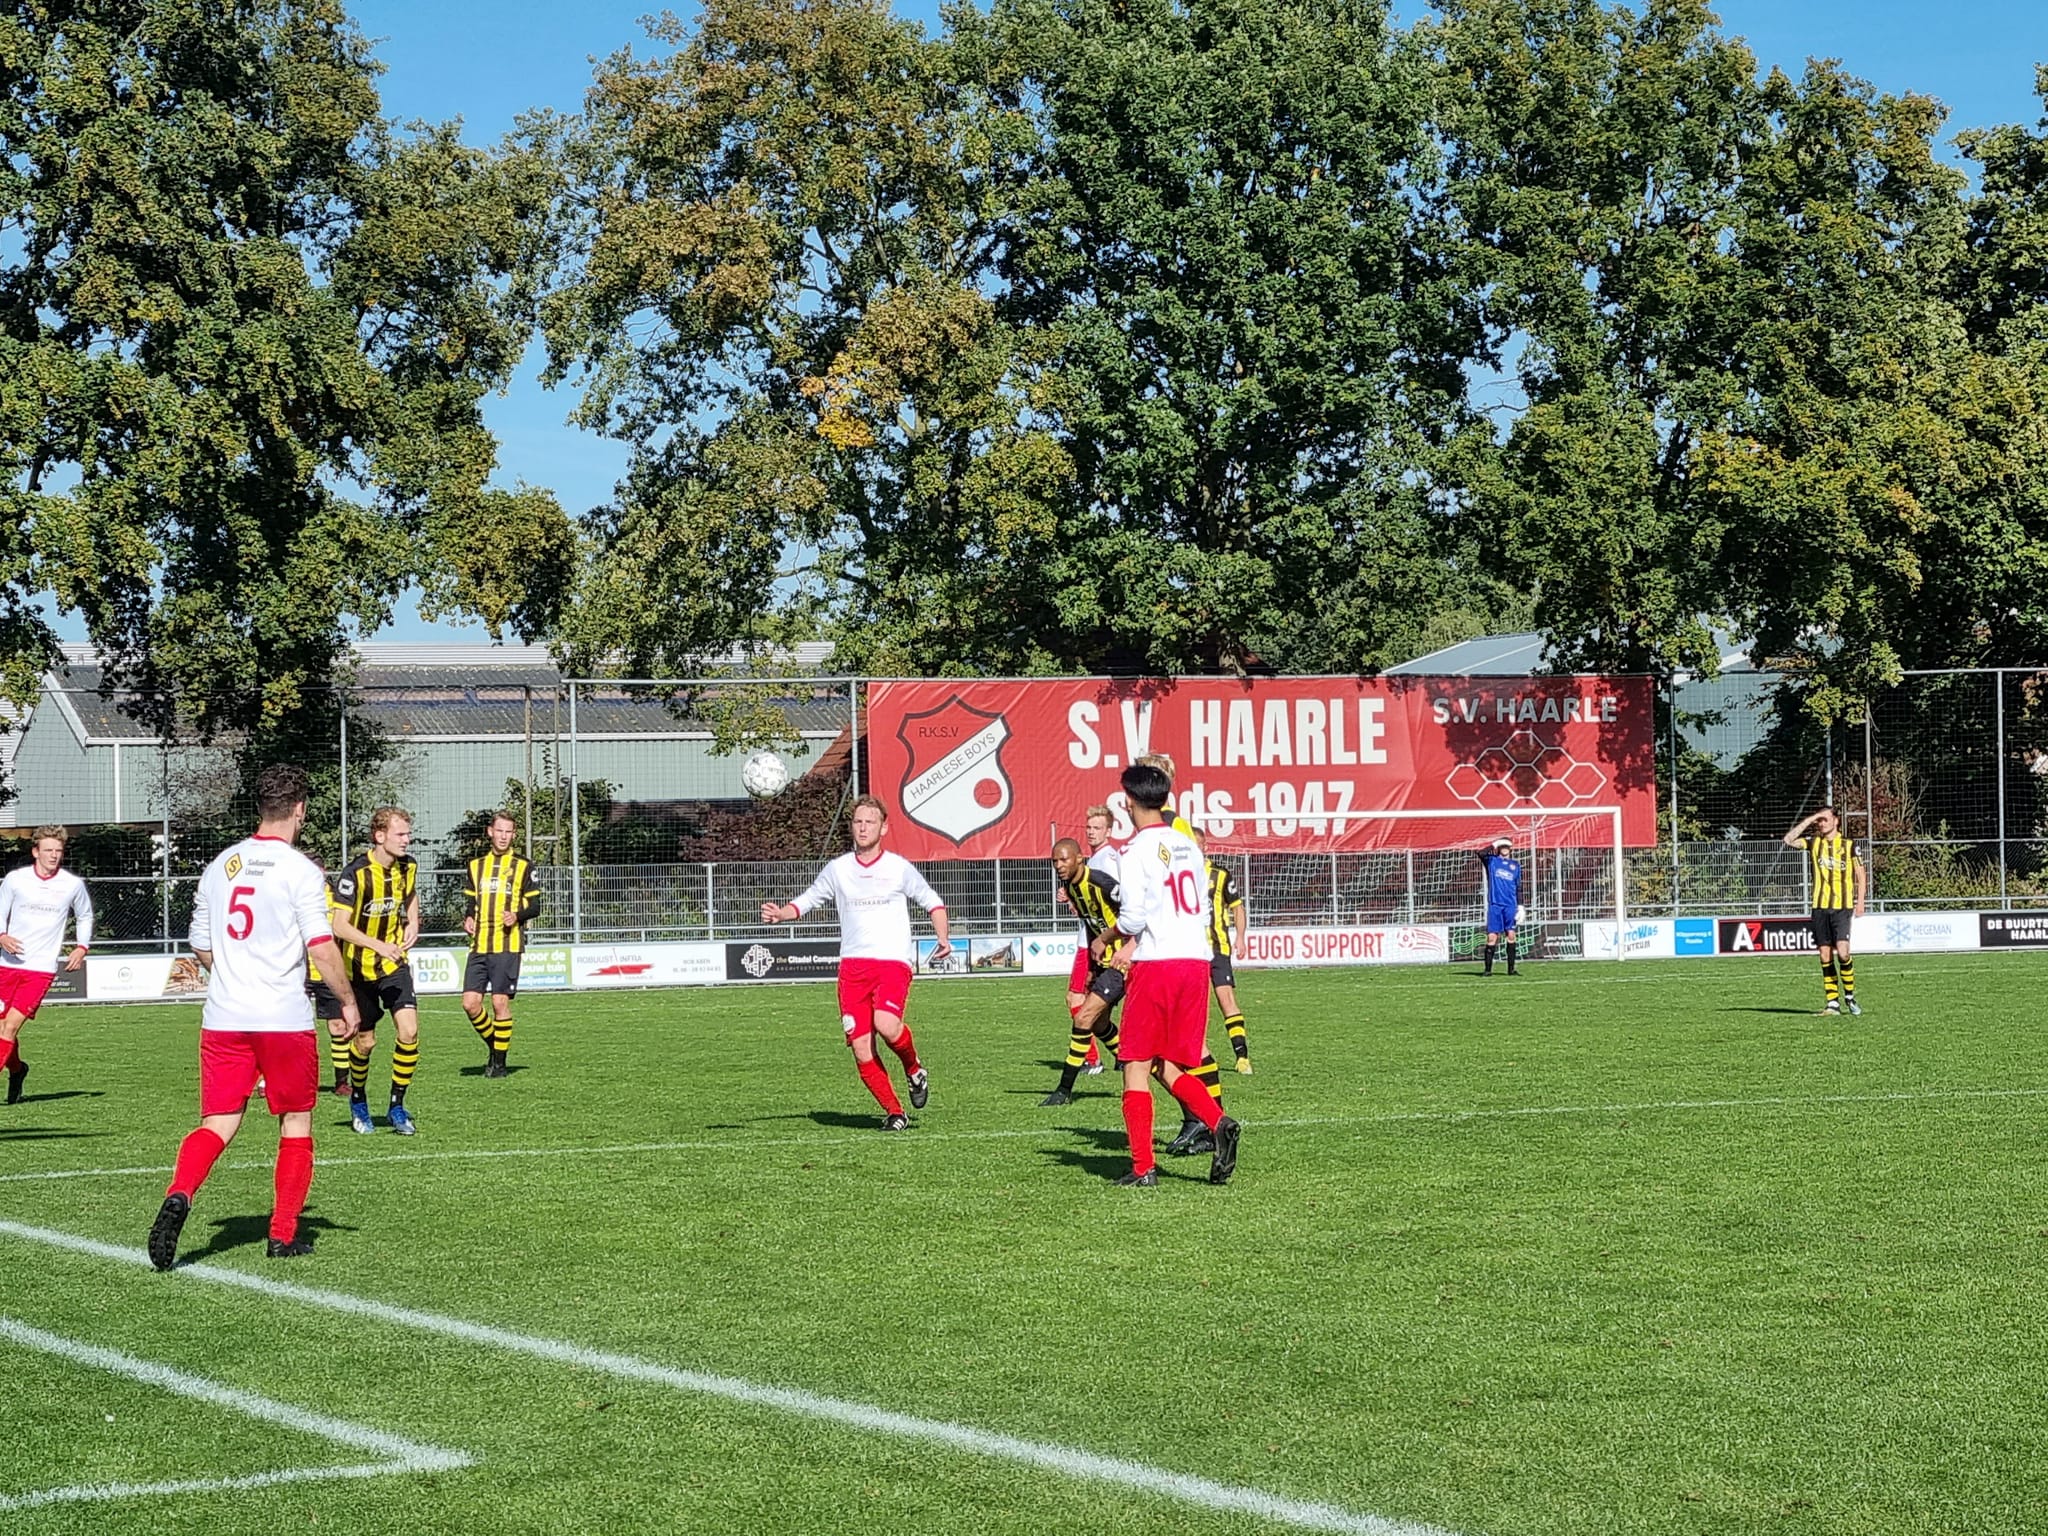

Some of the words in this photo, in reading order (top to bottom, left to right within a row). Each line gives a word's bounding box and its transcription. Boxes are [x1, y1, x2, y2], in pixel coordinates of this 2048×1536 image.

[1433, 697, 1487, 724] S.V.
[1496, 696, 1617, 723] HAARLE
[1067, 700, 1169, 769] S.V
[1190, 698, 1387, 766] HAARLE
[909, 754, 966, 800] HAARLESE
[965, 732, 997, 766] BOYS
[1106, 783, 1234, 839] sds
[1248, 781, 1354, 838] 1947
[1164, 869, 1201, 917] 10
[227, 886, 255, 940] 5
[1913, 924, 1952, 936] HEGEMAN
[1987, 919, 2002, 930] DE
[2011, 929, 2048, 940] HAARL
[1238, 935, 1294, 960] EUGD
[1301, 932, 1385, 958] SUPPORT
[1623, 939, 1651, 953] ENTRUM
[416, 953, 449, 971] tuin
[551, 949, 566, 961] de
[619, 954, 642, 963] INFRA
[776, 956, 787, 964] the
[788, 955, 812, 964] Citadel
[546, 961, 567, 973] tuin
